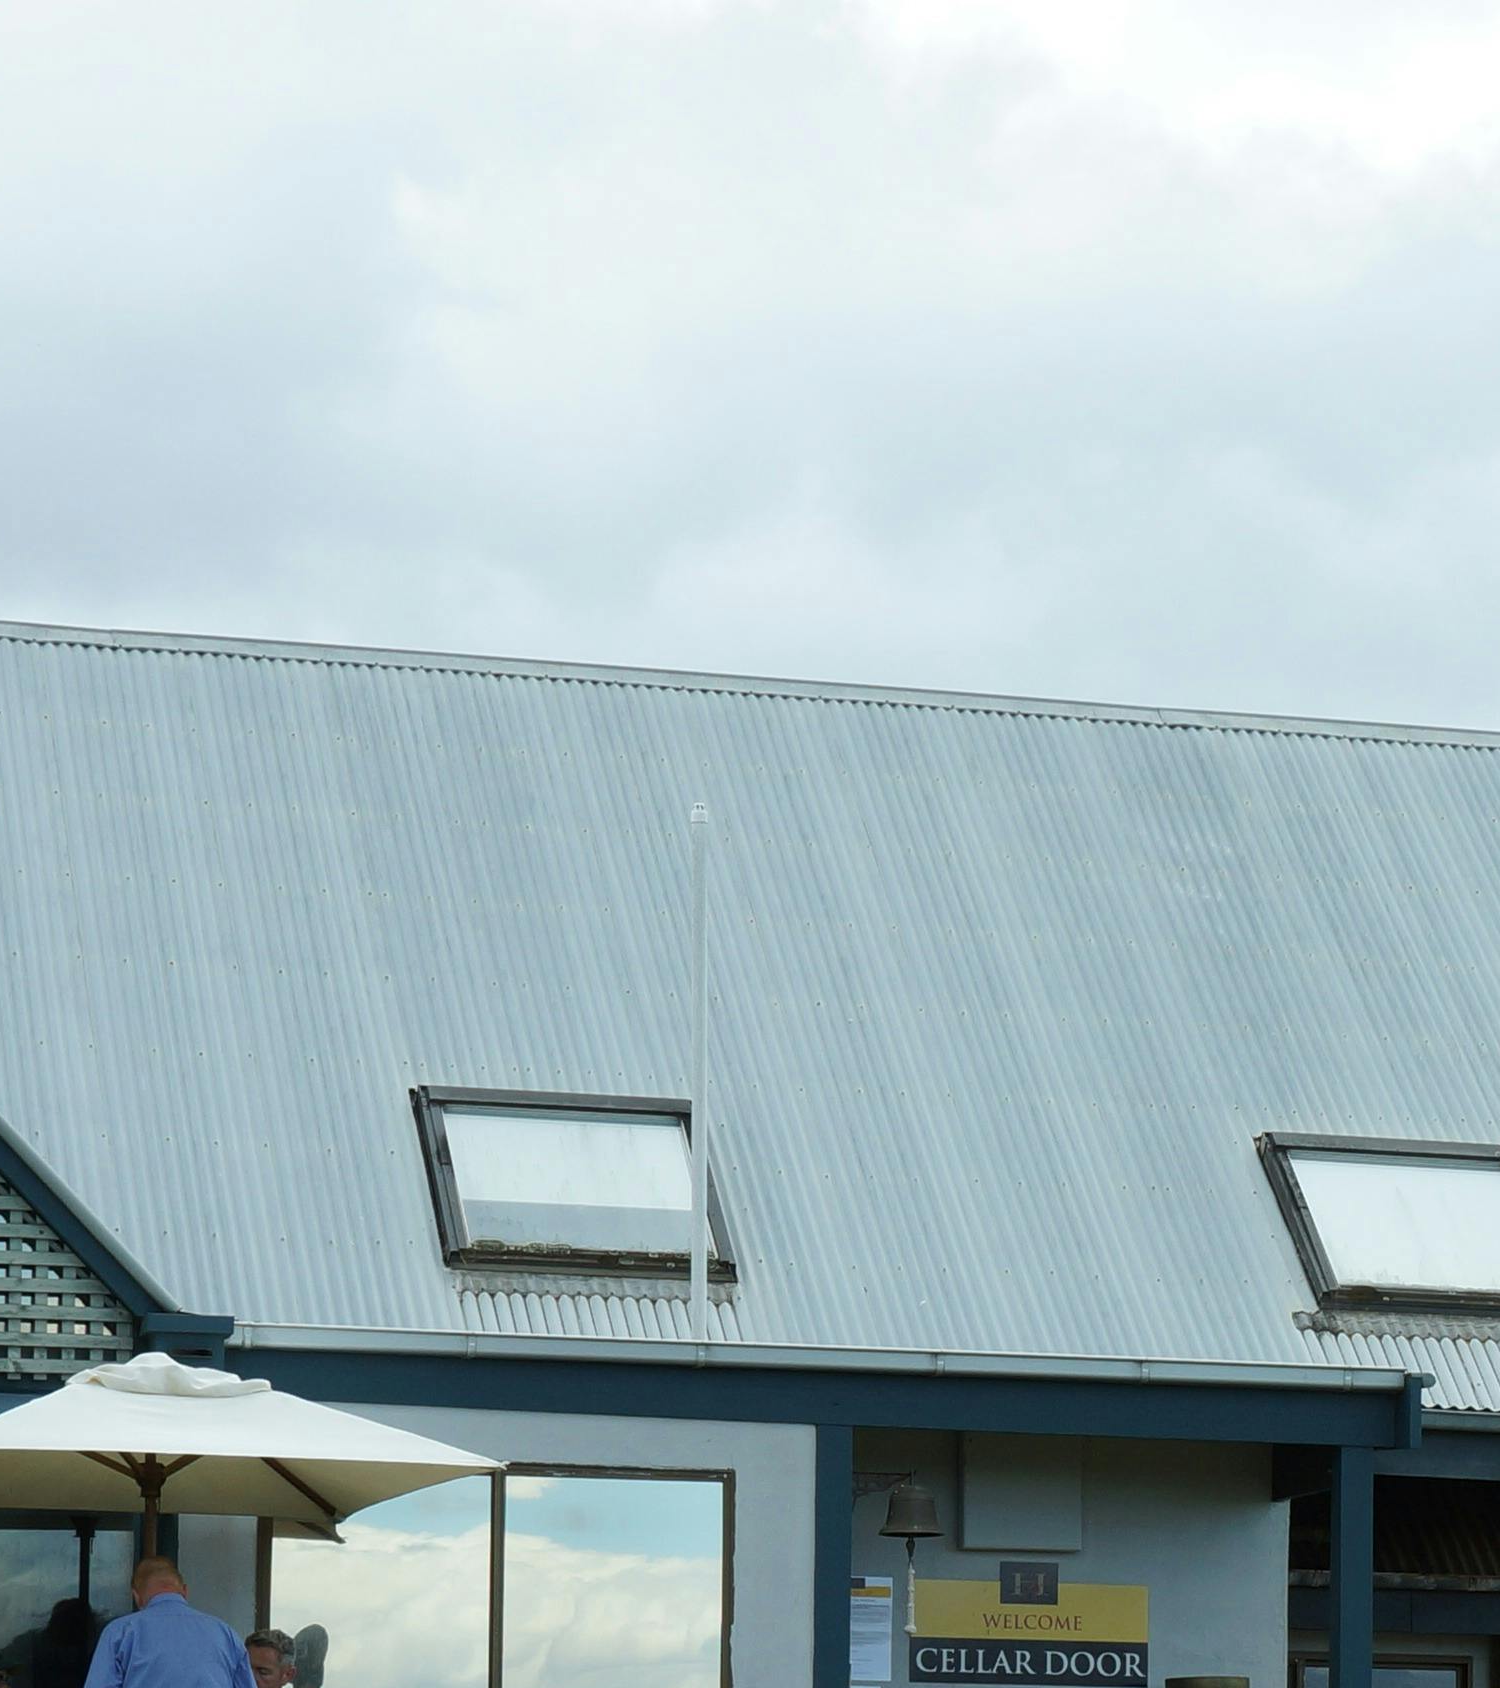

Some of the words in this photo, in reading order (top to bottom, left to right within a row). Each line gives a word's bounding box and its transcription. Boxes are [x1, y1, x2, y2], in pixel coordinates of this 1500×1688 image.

[982, 1613, 1083, 1632] WELCOME
[915, 1647, 1036, 1676] CELLAR
[1045, 1650, 1147, 1679] DOOR
